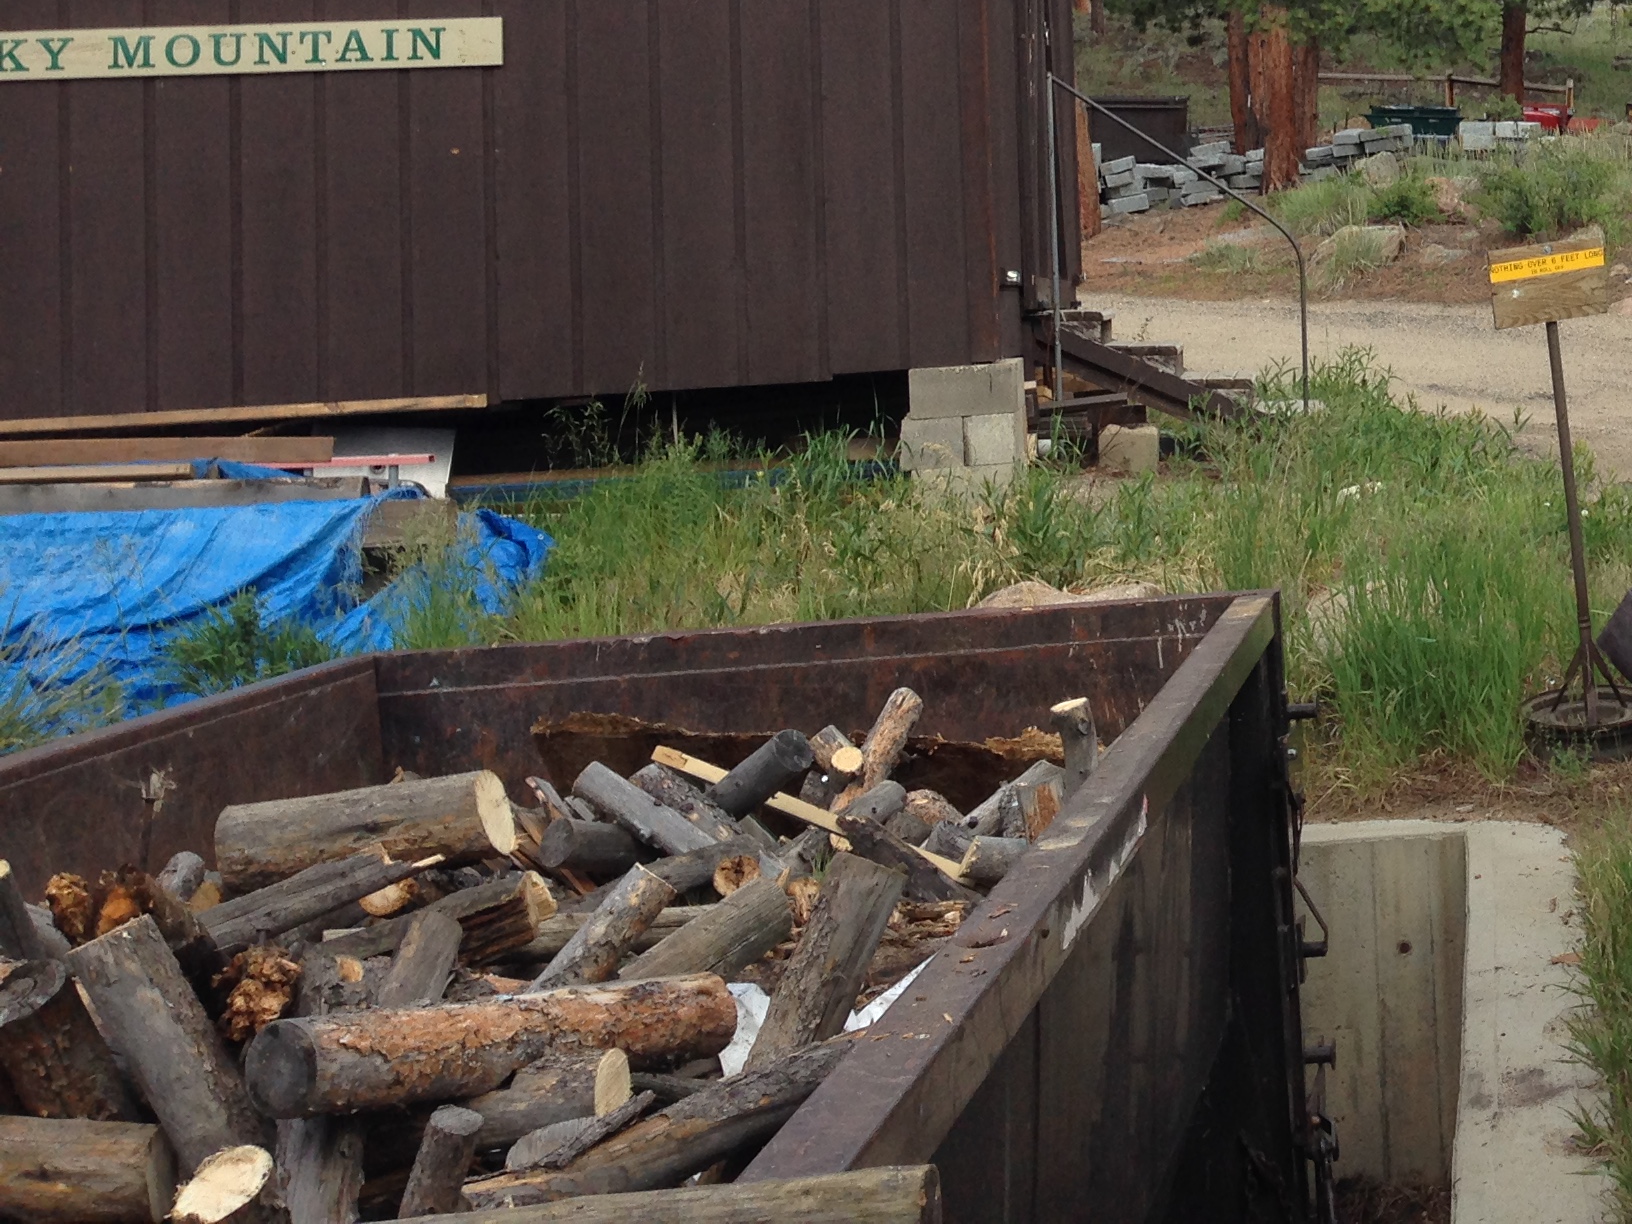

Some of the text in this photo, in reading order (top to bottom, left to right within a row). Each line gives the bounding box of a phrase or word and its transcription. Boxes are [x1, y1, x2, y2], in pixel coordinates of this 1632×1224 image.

[107, 27, 447, 69] MOUNTAIN
[1491, 262, 1523, 273] NOTHING
[1527, 259, 1547, 268] OVER
[1560, 254, 1579, 262] FEET
